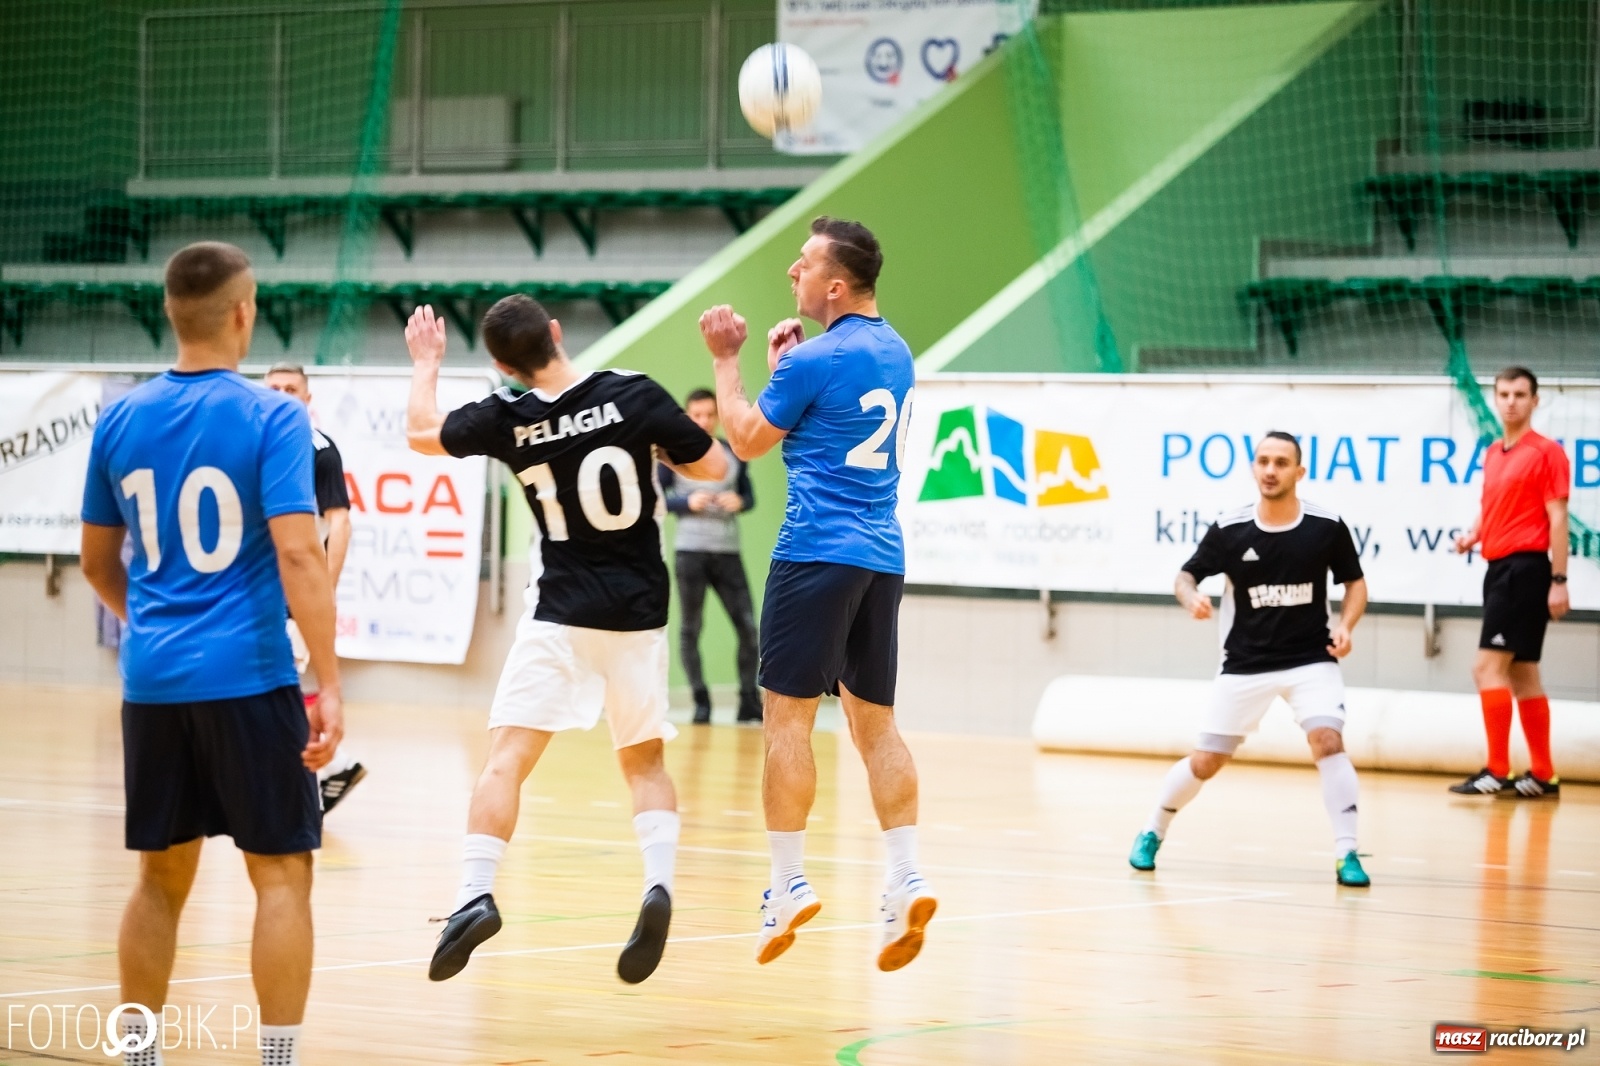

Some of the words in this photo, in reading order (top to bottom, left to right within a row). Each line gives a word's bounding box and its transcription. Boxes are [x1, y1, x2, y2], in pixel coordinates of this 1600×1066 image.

[513, 401, 624, 448] PELAGIA
[120, 466, 244, 573] 10
[516, 445, 642, 542] 10
